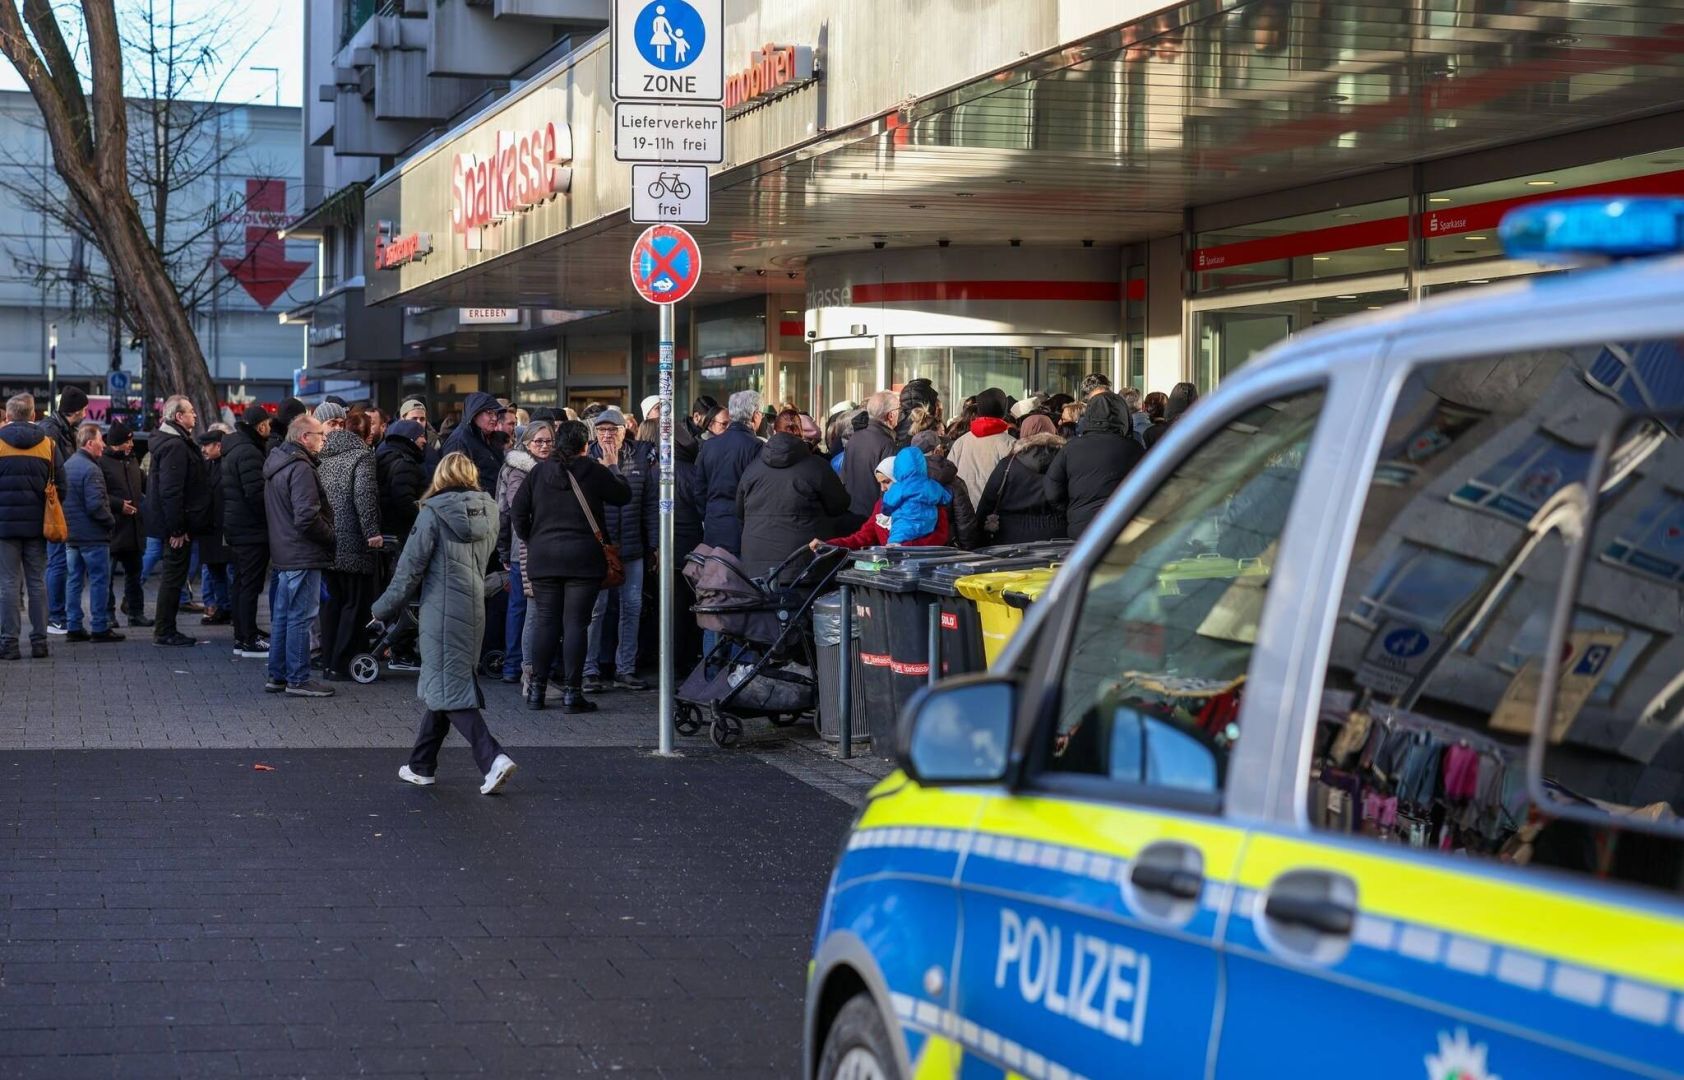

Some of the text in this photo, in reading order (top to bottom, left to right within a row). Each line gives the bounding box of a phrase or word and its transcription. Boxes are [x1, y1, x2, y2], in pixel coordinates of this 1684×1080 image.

[643, 74, 697, 93] ZONE
[621, 115, 718, 130] Lieferverkehr
[632, 136, 707, 151] 19-11h frei
[452, 121, 560, 251] Sparkasse
[658, 203, 681, 216] frei
[1439, 218, 1467, 232] Sparkasse
[469, 309, 506, 318] ERLEBEN
[995, 908, 1151, 1046] POLIZEI
